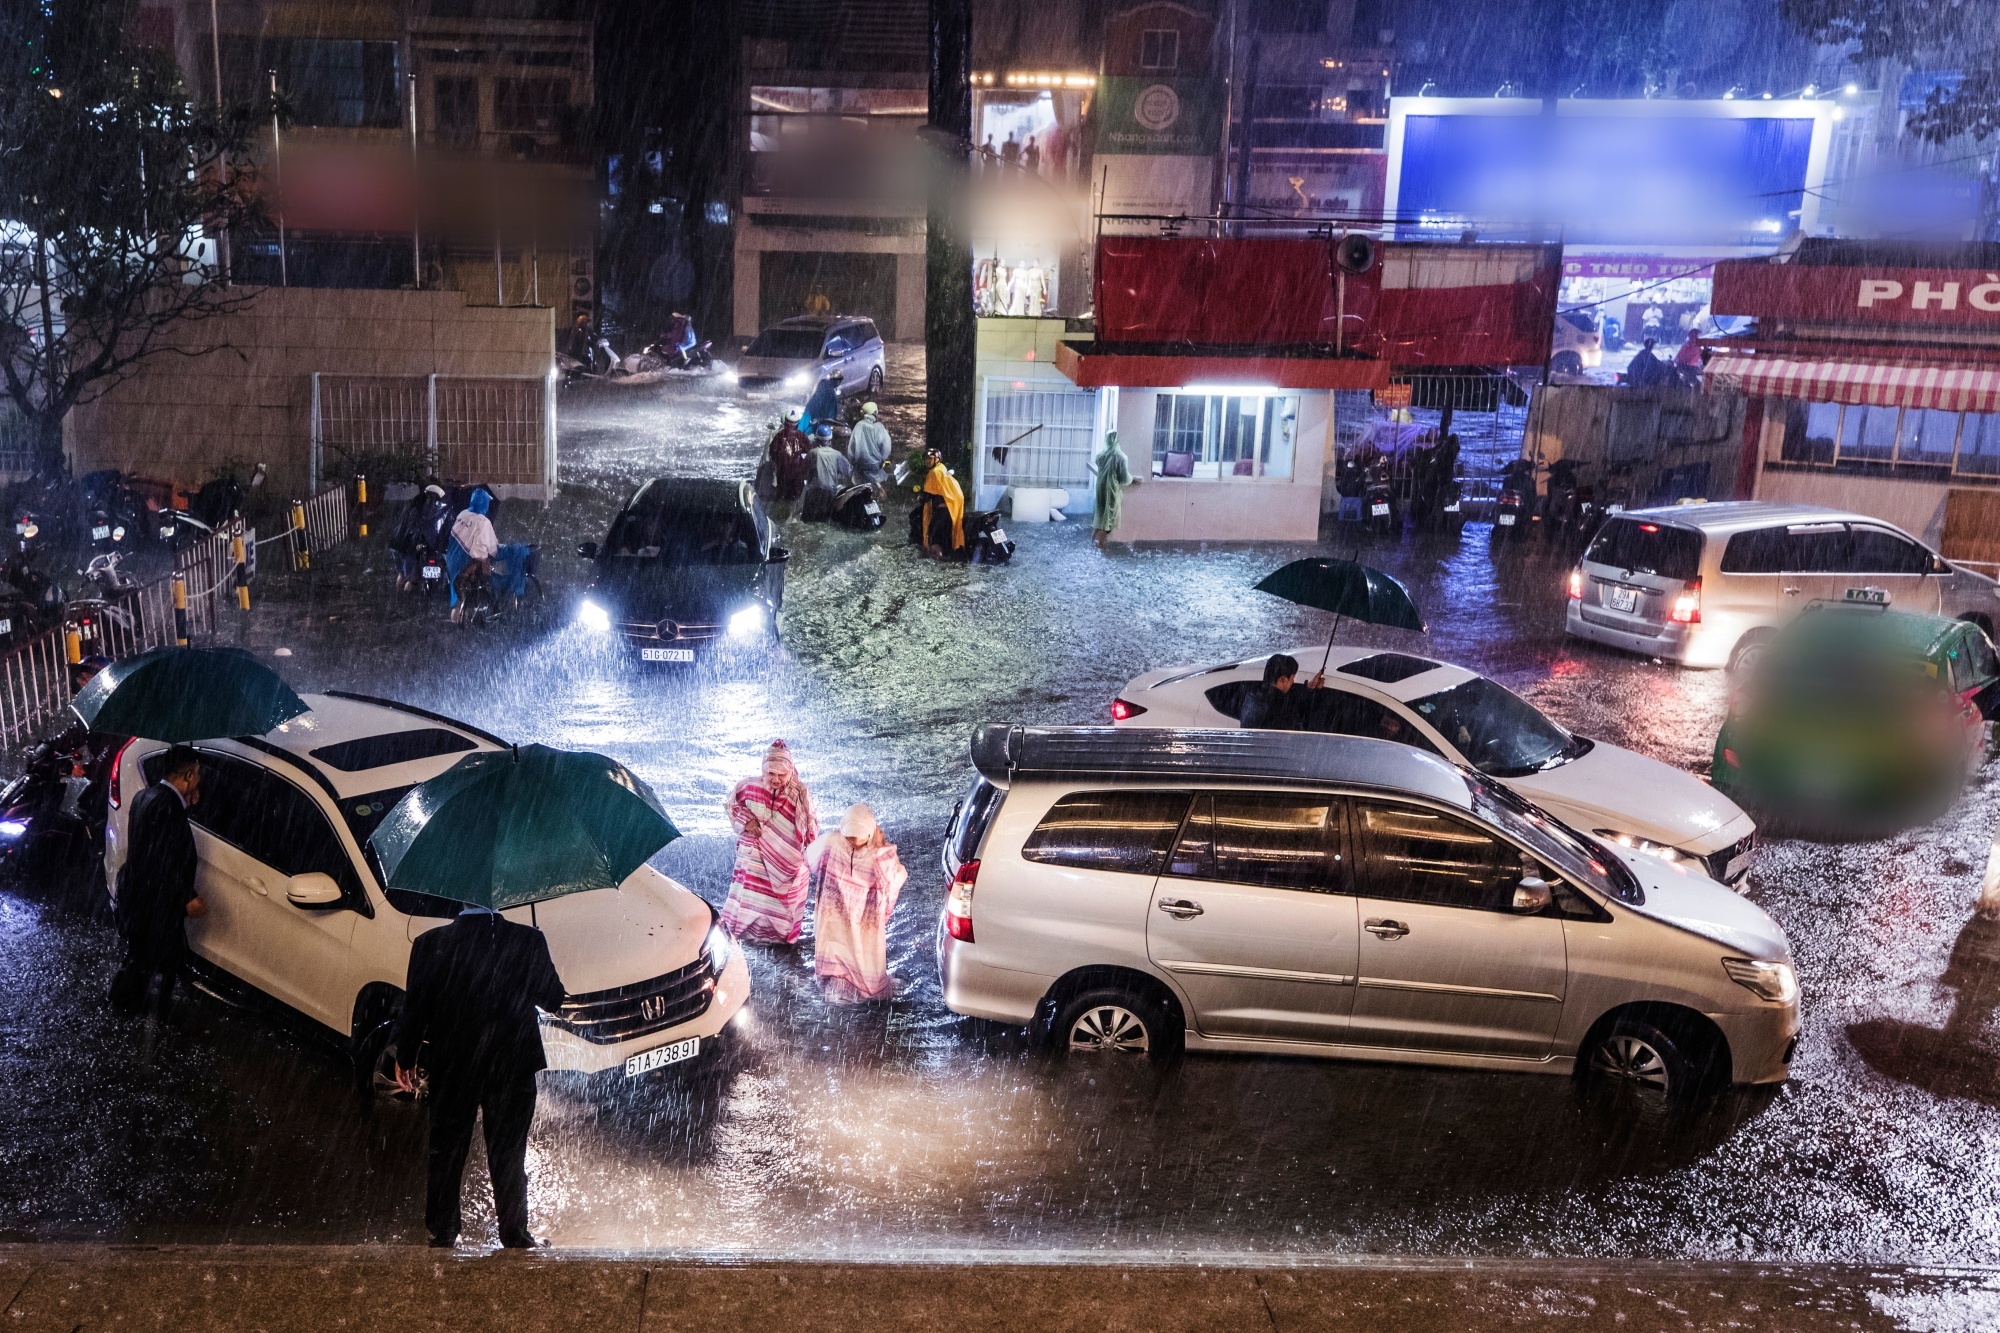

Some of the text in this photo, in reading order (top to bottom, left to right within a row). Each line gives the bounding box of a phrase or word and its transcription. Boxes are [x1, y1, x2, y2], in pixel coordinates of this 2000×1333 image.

[1589, 263, 1649, 274] THEO
[1618, 590, 1630, 600] 29A
[1852, 590, 1879, 602] TAXI
